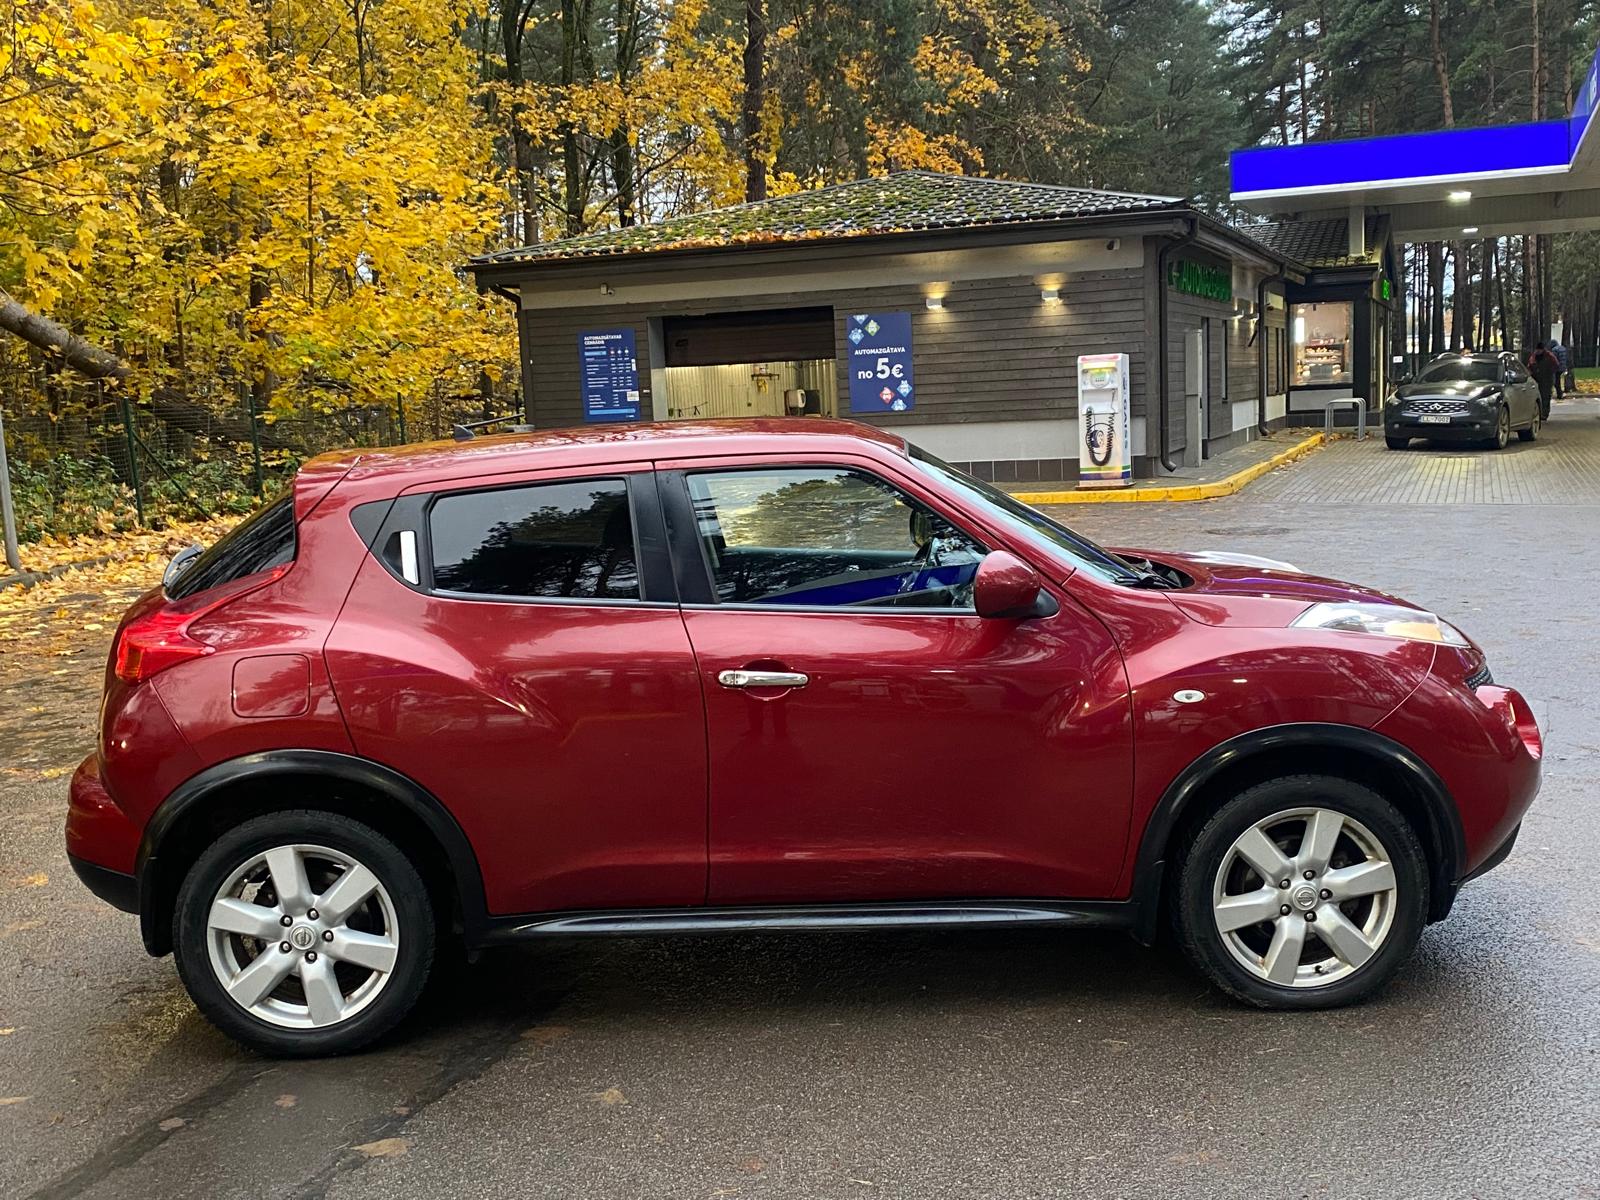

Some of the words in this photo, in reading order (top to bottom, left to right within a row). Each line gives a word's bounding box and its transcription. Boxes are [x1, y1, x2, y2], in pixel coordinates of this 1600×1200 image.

[854, 346, 906, 356] AUTOMAZGĀTAVA
[858, 370, 873, 379] no
[876, 357, 904, 379] 5€
